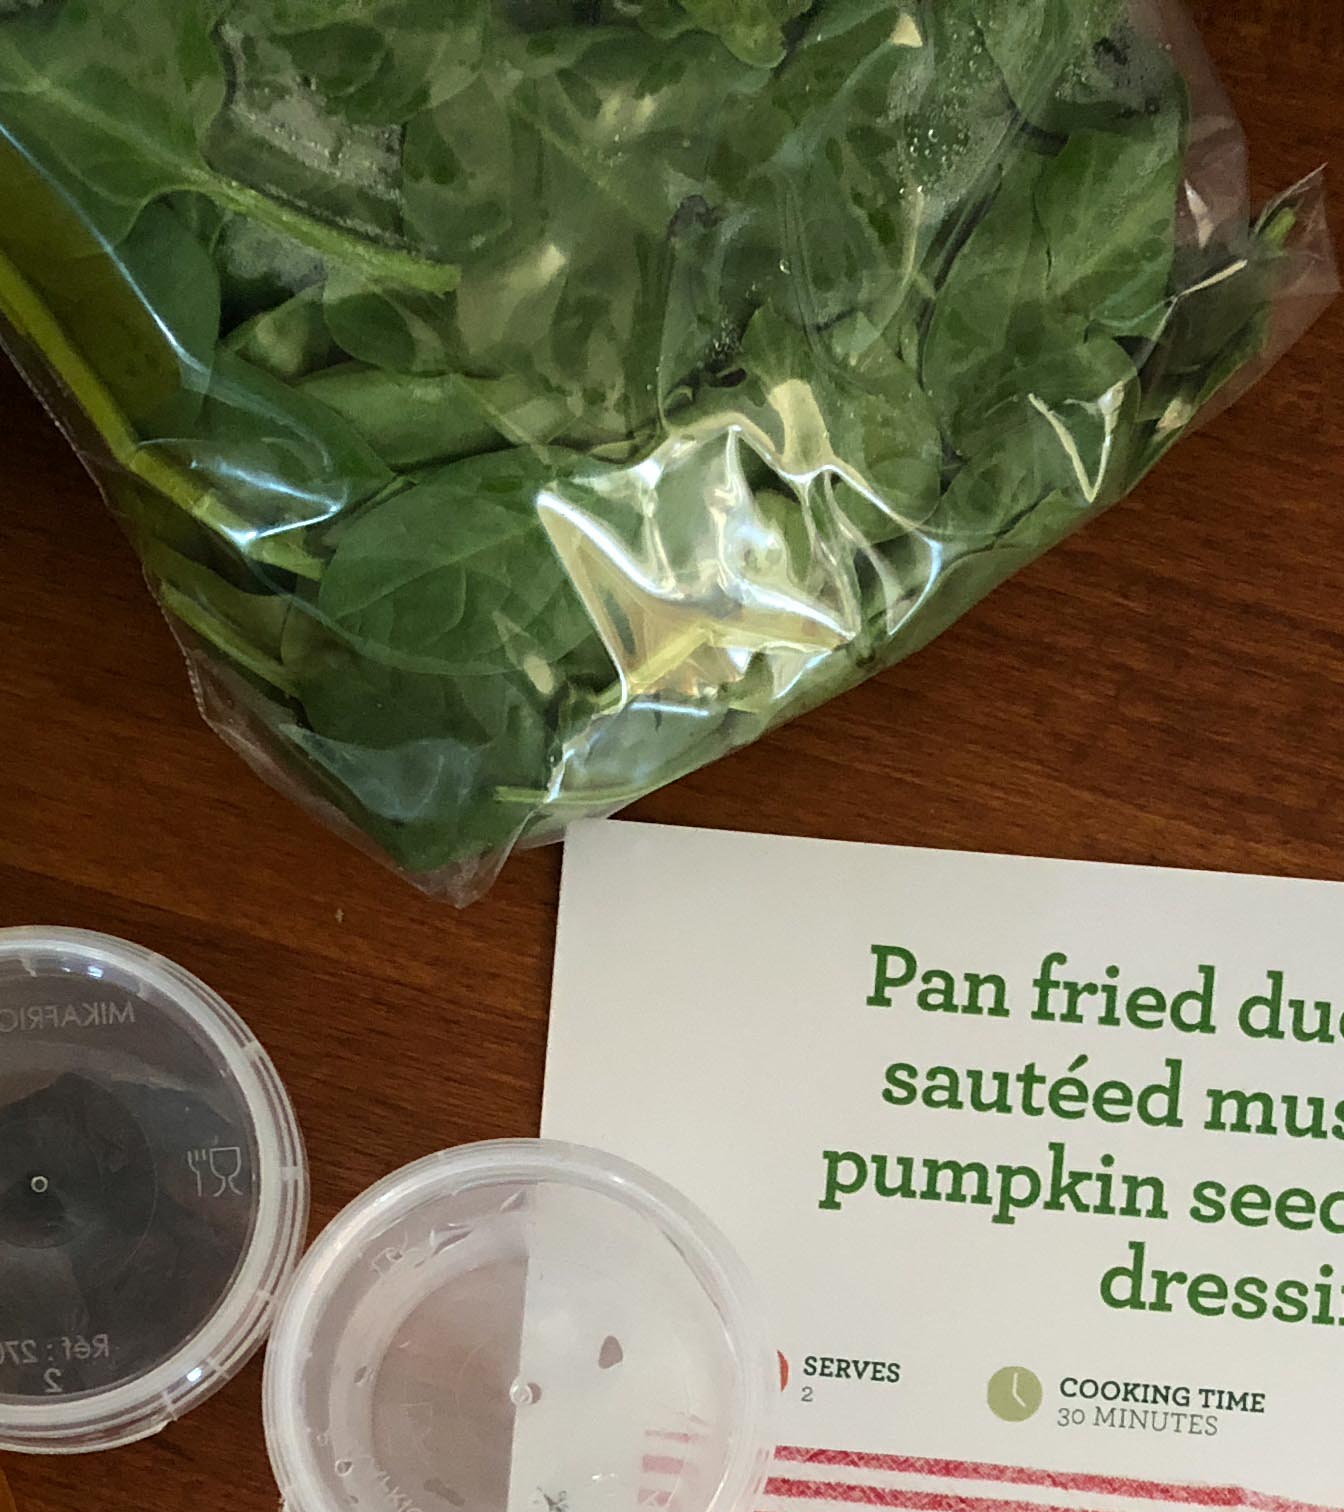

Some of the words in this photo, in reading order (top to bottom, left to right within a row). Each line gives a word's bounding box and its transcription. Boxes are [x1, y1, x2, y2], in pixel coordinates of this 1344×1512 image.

[867, 945, 1009, 1017] Pan
[1031, 952, 1216, 1034] fried
[882, 1054, 1183, 1127] sautéed
[819, 1142, 1168, 1224] pumpkin
[803, 1355, 901, 1384] SERVES
[801, 1386, 813, 1402] 2
[1059, 1377, 1191, 1407] COOKING
[1198, 1388, 1266, 1414] TIME
[1057, 1407, 1086, 1427] 30
[1093, 1406, 1218, 1436] MINUTES
